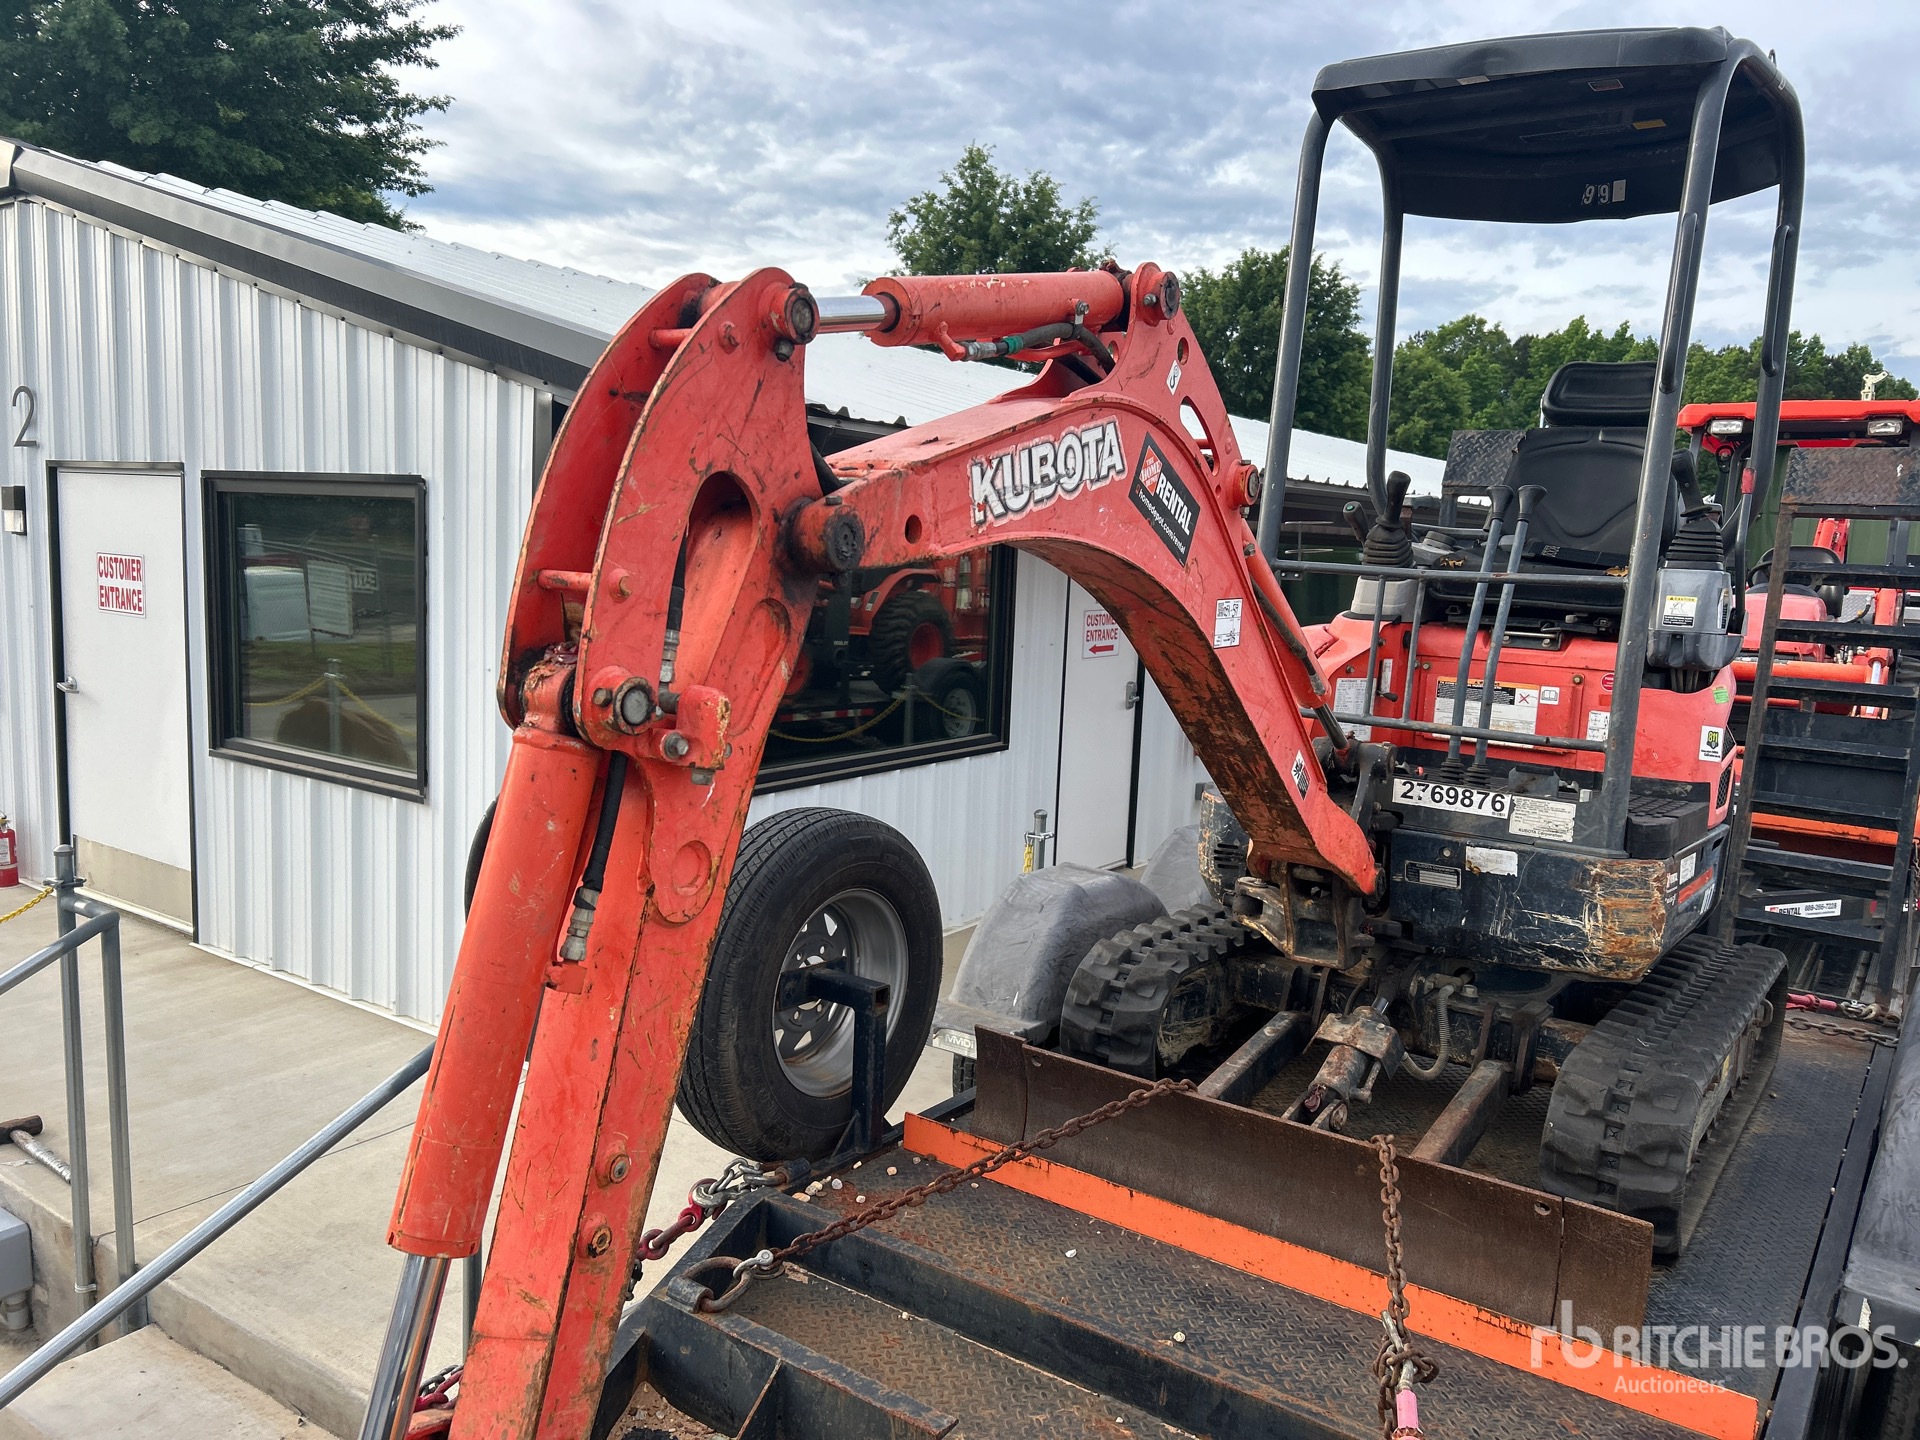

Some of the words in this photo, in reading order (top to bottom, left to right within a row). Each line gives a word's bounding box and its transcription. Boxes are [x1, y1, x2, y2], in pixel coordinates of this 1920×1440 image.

[12, 385, 37, 448] 2
[970, 421, 1125, 525] KUBOTA
[1140, 461, 1162, 483] HOME
[1156, 472, 1192, 535] RENTAL
[1138, 488, 1186, 555] homedepot.com/rental
[98, 555, 142, 581] CUSTOMER
[99, 584, 143, 612] ENTRANCE
[1086, 613, 1117, 627] CUSTOME
[1086, 627, 1119, 643] ENTRANCE
[1708, 731, 1718, 743] 811
[1400, 781, 1505, 812] 2769876
